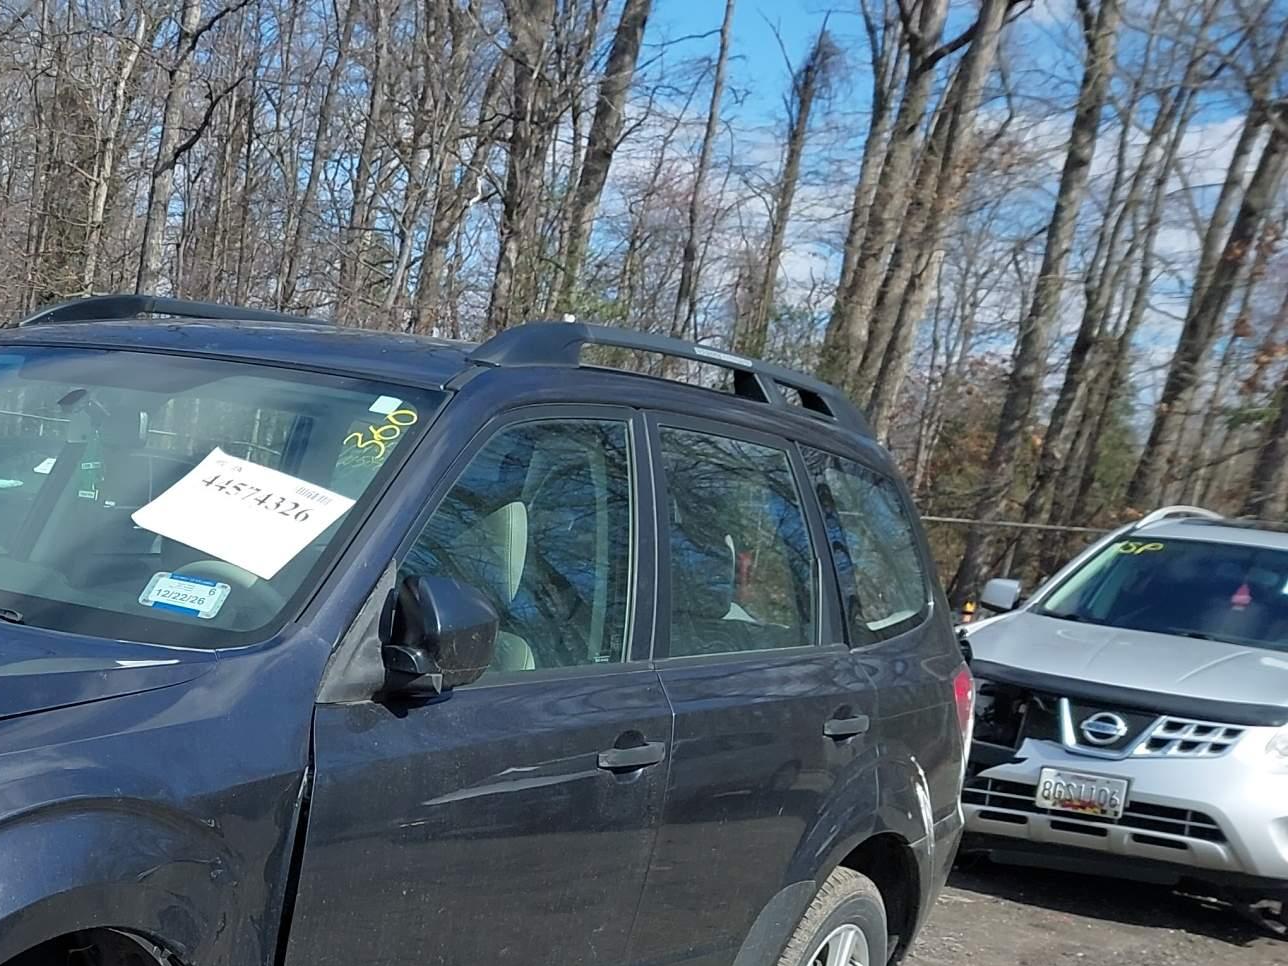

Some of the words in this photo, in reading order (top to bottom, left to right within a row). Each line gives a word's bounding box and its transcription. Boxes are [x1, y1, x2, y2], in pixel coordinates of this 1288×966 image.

[343, 409, 418, 460] 360
[202, 474, 313, 523] 44574326
[154, 588, 206, 606] 12/22/26
[208, 588, 217, 596] 6
